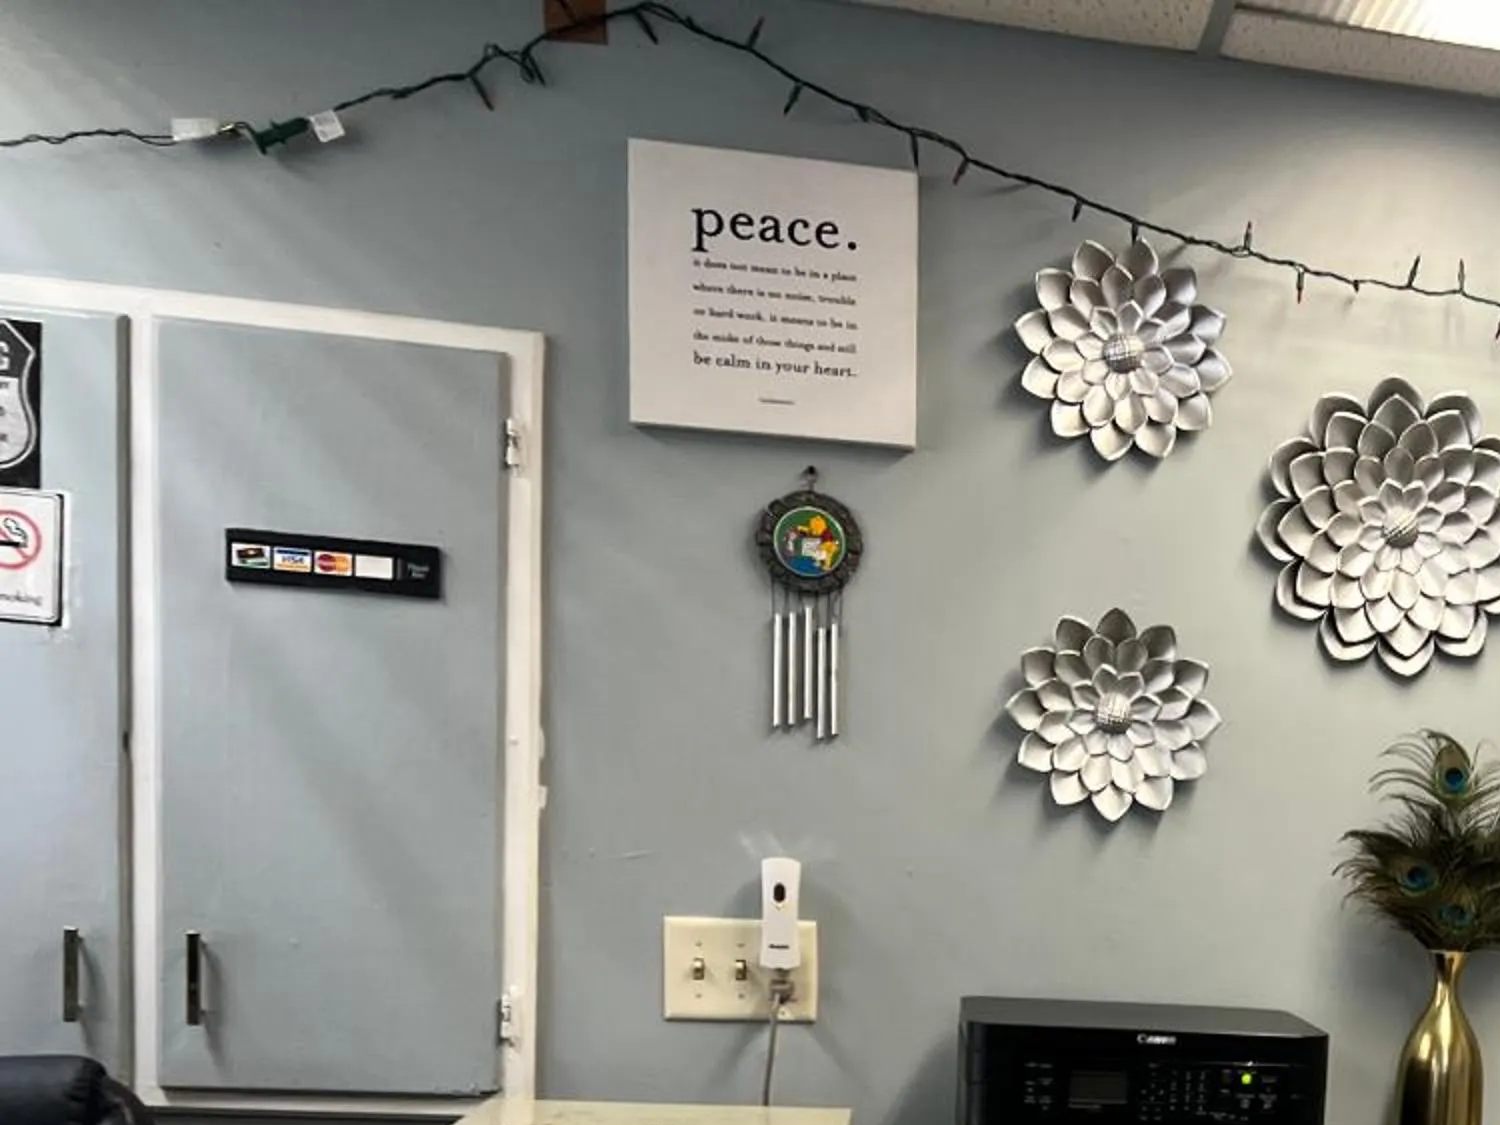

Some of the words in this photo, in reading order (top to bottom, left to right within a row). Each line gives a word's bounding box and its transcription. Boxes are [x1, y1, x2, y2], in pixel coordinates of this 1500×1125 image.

[691, 207, 858, 253] peace.
[794, 265, 806, 277] be
[693, 281, 723, 293] where
[727, 283, 753, 296] there
[708, 306, 734, 318] hard
[742, 334, 754, 344] of
[784, 338, 815, 353] things
[817, 342, 835, 352] and
[693, 349, 711, 366] be
[715, 352, 751, 369] calm
[756, 355, 771, 370] in
[775, 360, 810, 375] your
